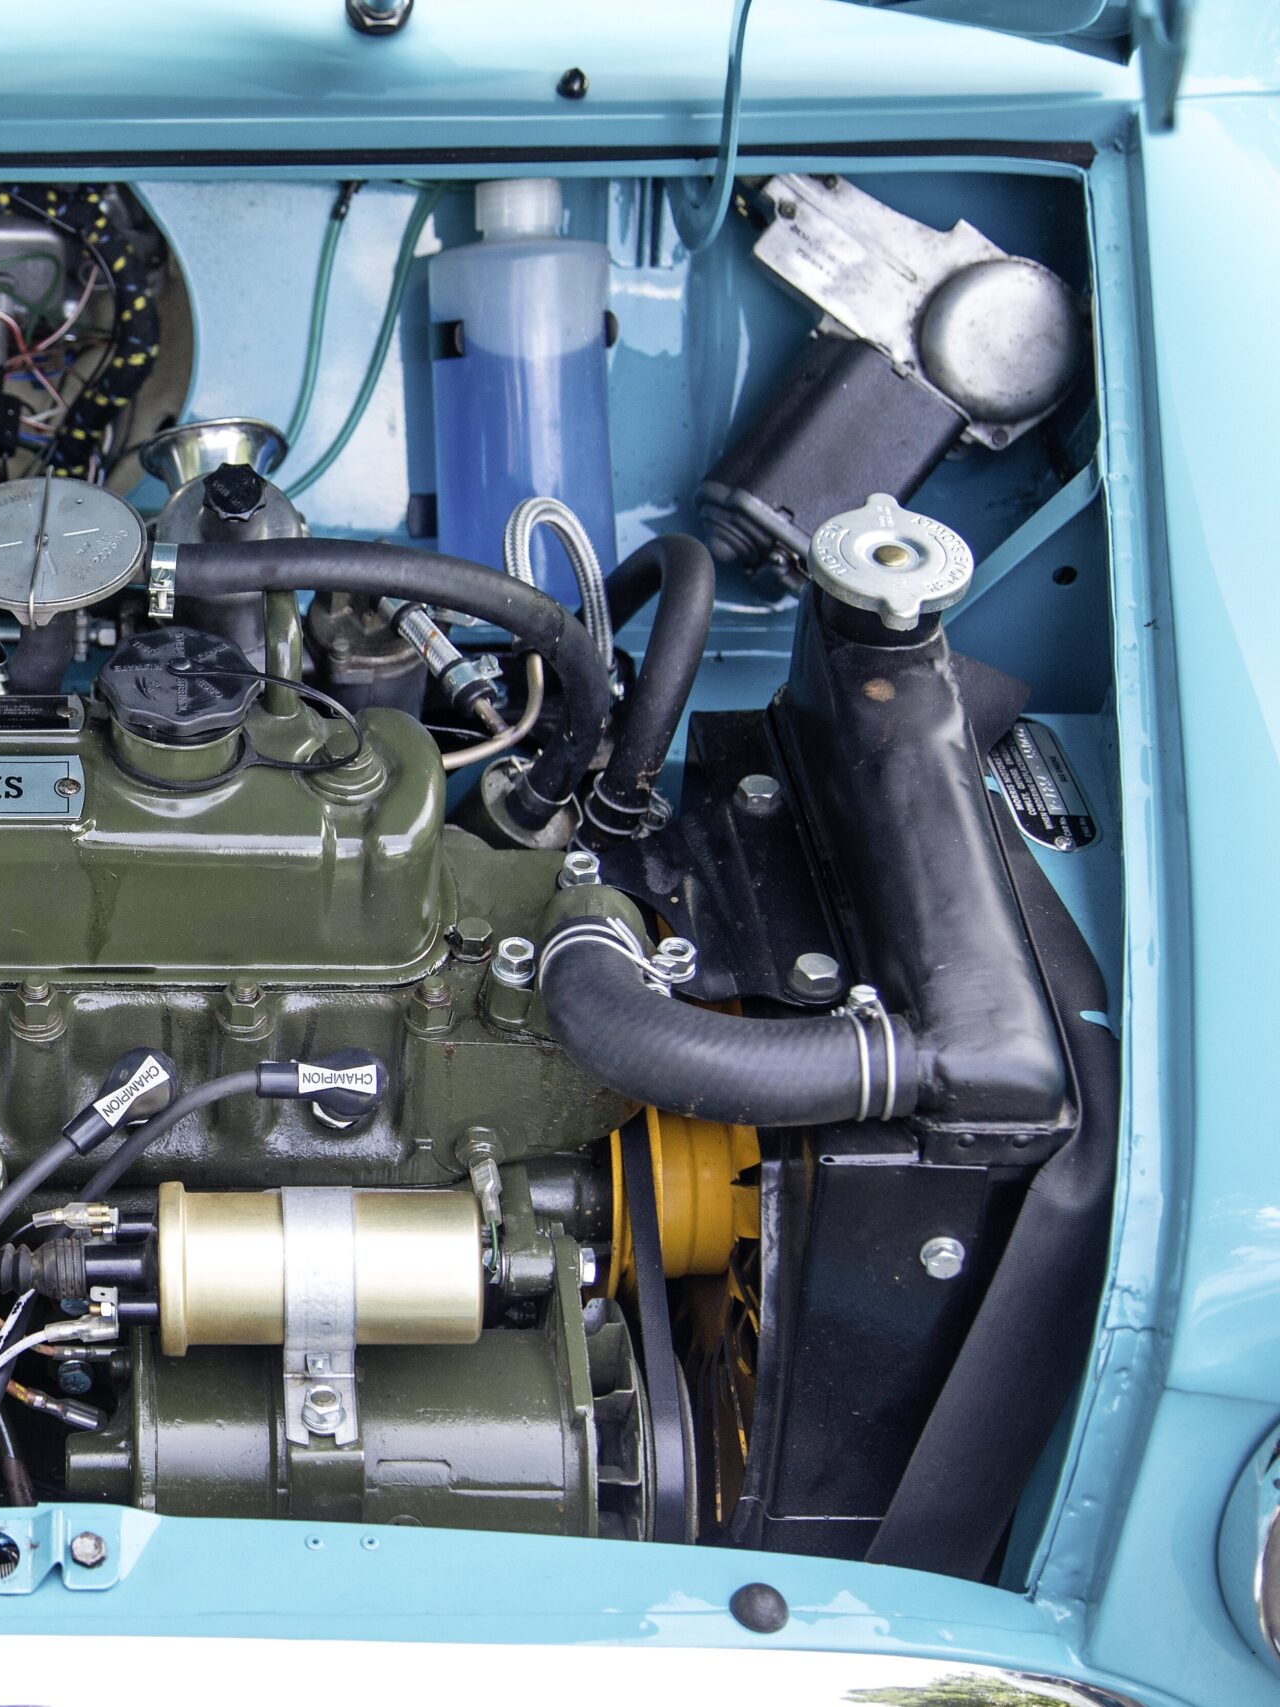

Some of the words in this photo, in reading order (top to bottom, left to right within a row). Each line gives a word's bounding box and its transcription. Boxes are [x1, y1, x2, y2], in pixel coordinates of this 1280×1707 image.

[817, 521, 848, 577] TIGHTEN
[910, 516, 965, 552] SLOWLY
[926, 555, 969, 592] REMOVE
[1006, 783, 1024, 811] MORRIS
[1040, 811, 1053, 830] WHEN
[102, 1065, 160, 1118] CHAMPION
[302, 1072, 373, 1085] CHAMPION
